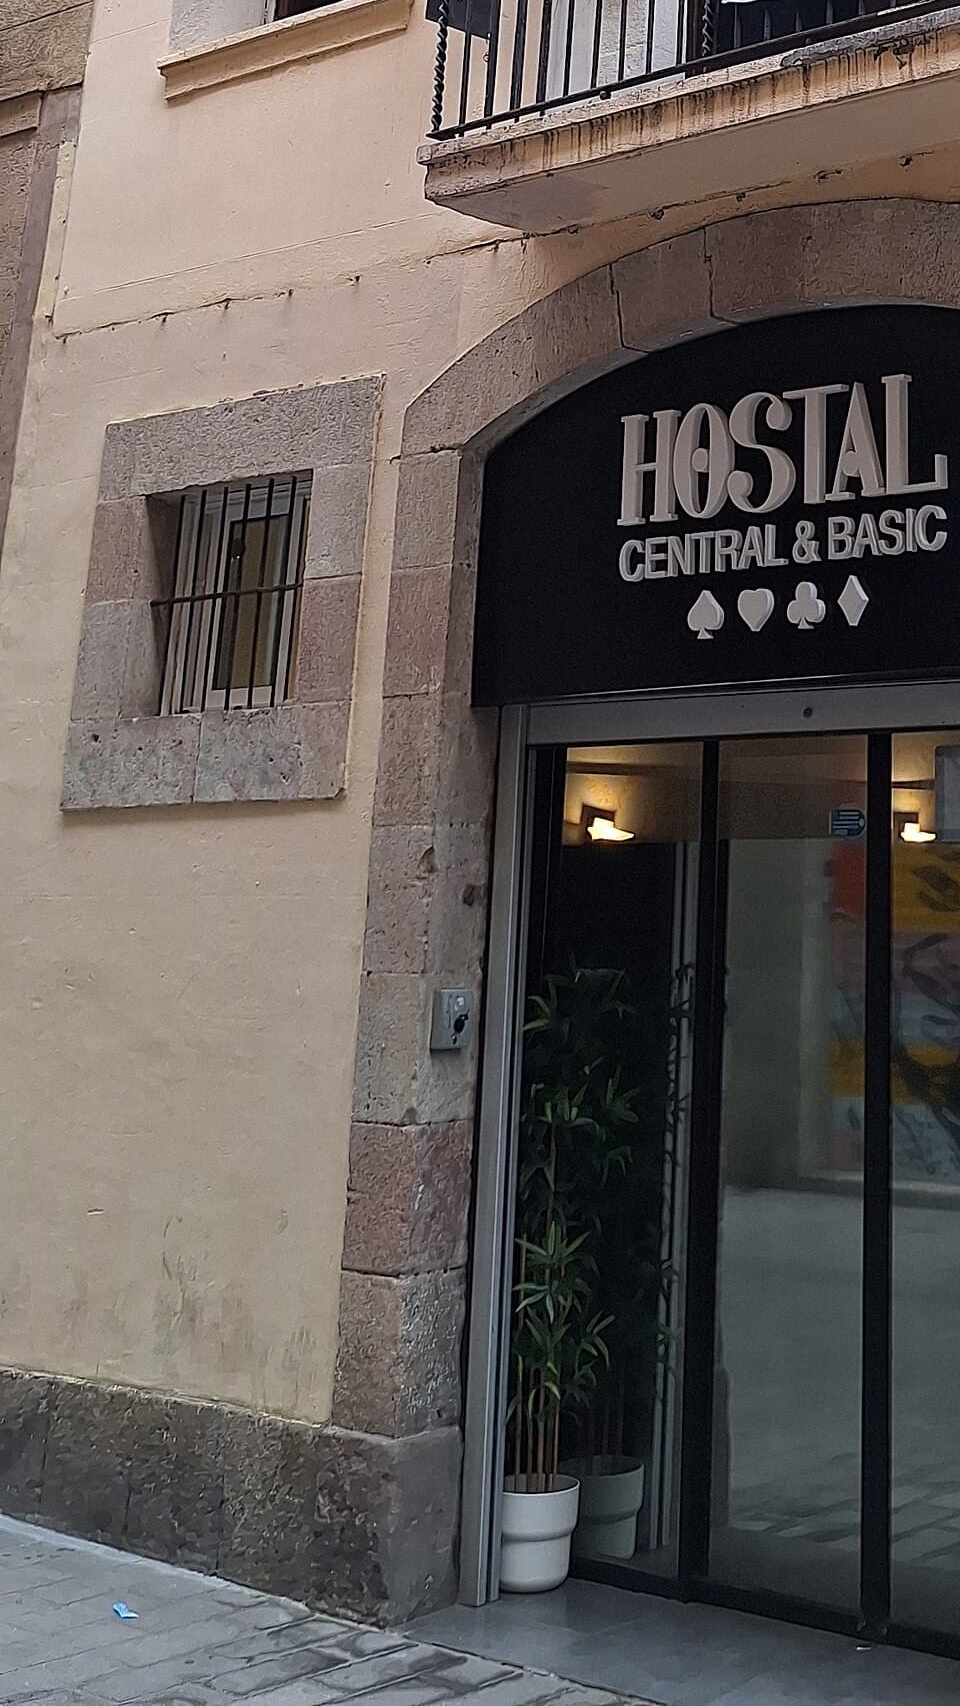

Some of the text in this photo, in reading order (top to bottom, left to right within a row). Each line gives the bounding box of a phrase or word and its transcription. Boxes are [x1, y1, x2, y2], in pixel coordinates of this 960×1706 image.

[617, 374, 948, 526] HOSTAL
[619, 504, 948, 582] CENTRAL & BASIC
